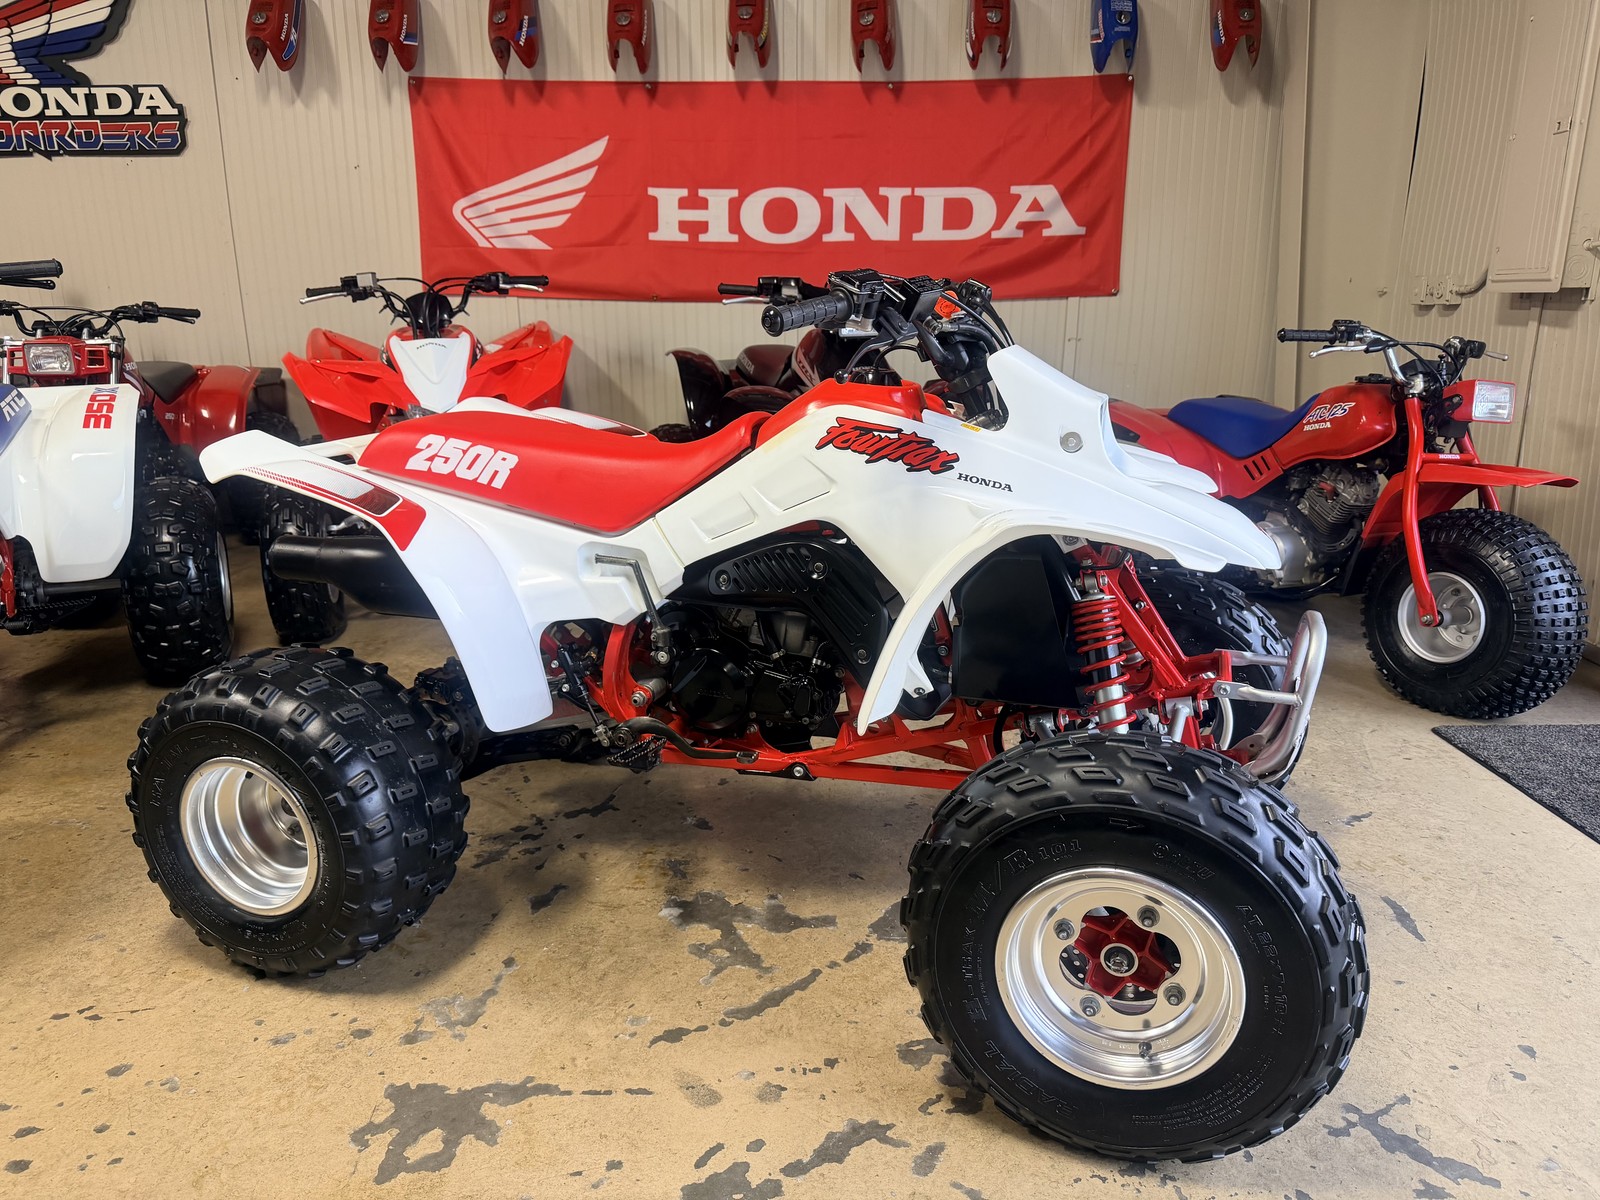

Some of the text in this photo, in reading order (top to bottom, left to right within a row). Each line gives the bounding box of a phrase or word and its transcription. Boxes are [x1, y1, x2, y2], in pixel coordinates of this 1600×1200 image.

[280, 13, 289, 42] HONDA
[400, 14, 408, 42] HONDA
[519, 15, 529, 47] HONDA
[1217, 9, 1226, 44] HONDA
[0, 86, 178, 117] ONDA
[647, 184, 1087, 244] HONDA
[1, 388, 28, 422] ATC
[1303, 421, 1332, 432] HONDA
[405, 433, 519, 490] 250R
[956, 472, 1014, 493] HONDA
